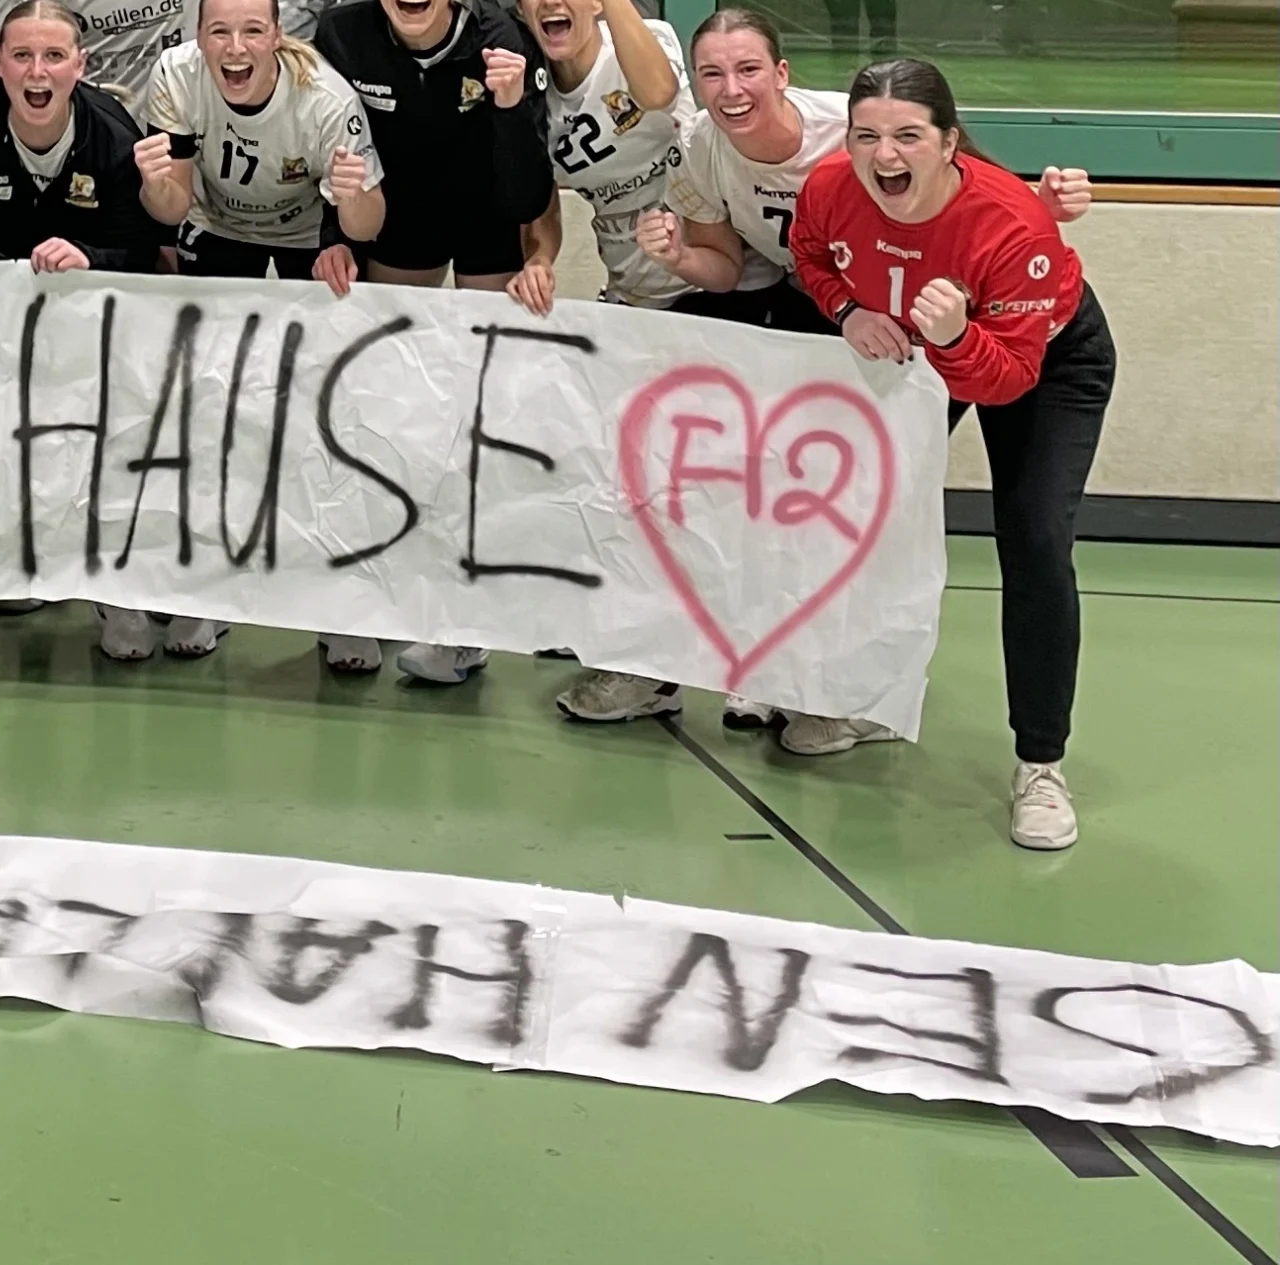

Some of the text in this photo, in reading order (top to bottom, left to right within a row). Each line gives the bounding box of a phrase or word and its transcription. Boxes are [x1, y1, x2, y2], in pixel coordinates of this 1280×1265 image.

[220, 140, 259, 186] 17
[554, 113, 617, 175] 22
[754, 185, 798, 201] Kempa
[762, 206, 793, 248] 7
[876, 239, 923, 260] Kempa
[888, 266, 906, 318] 1
[11, 291, 603, 588] HAUSE
